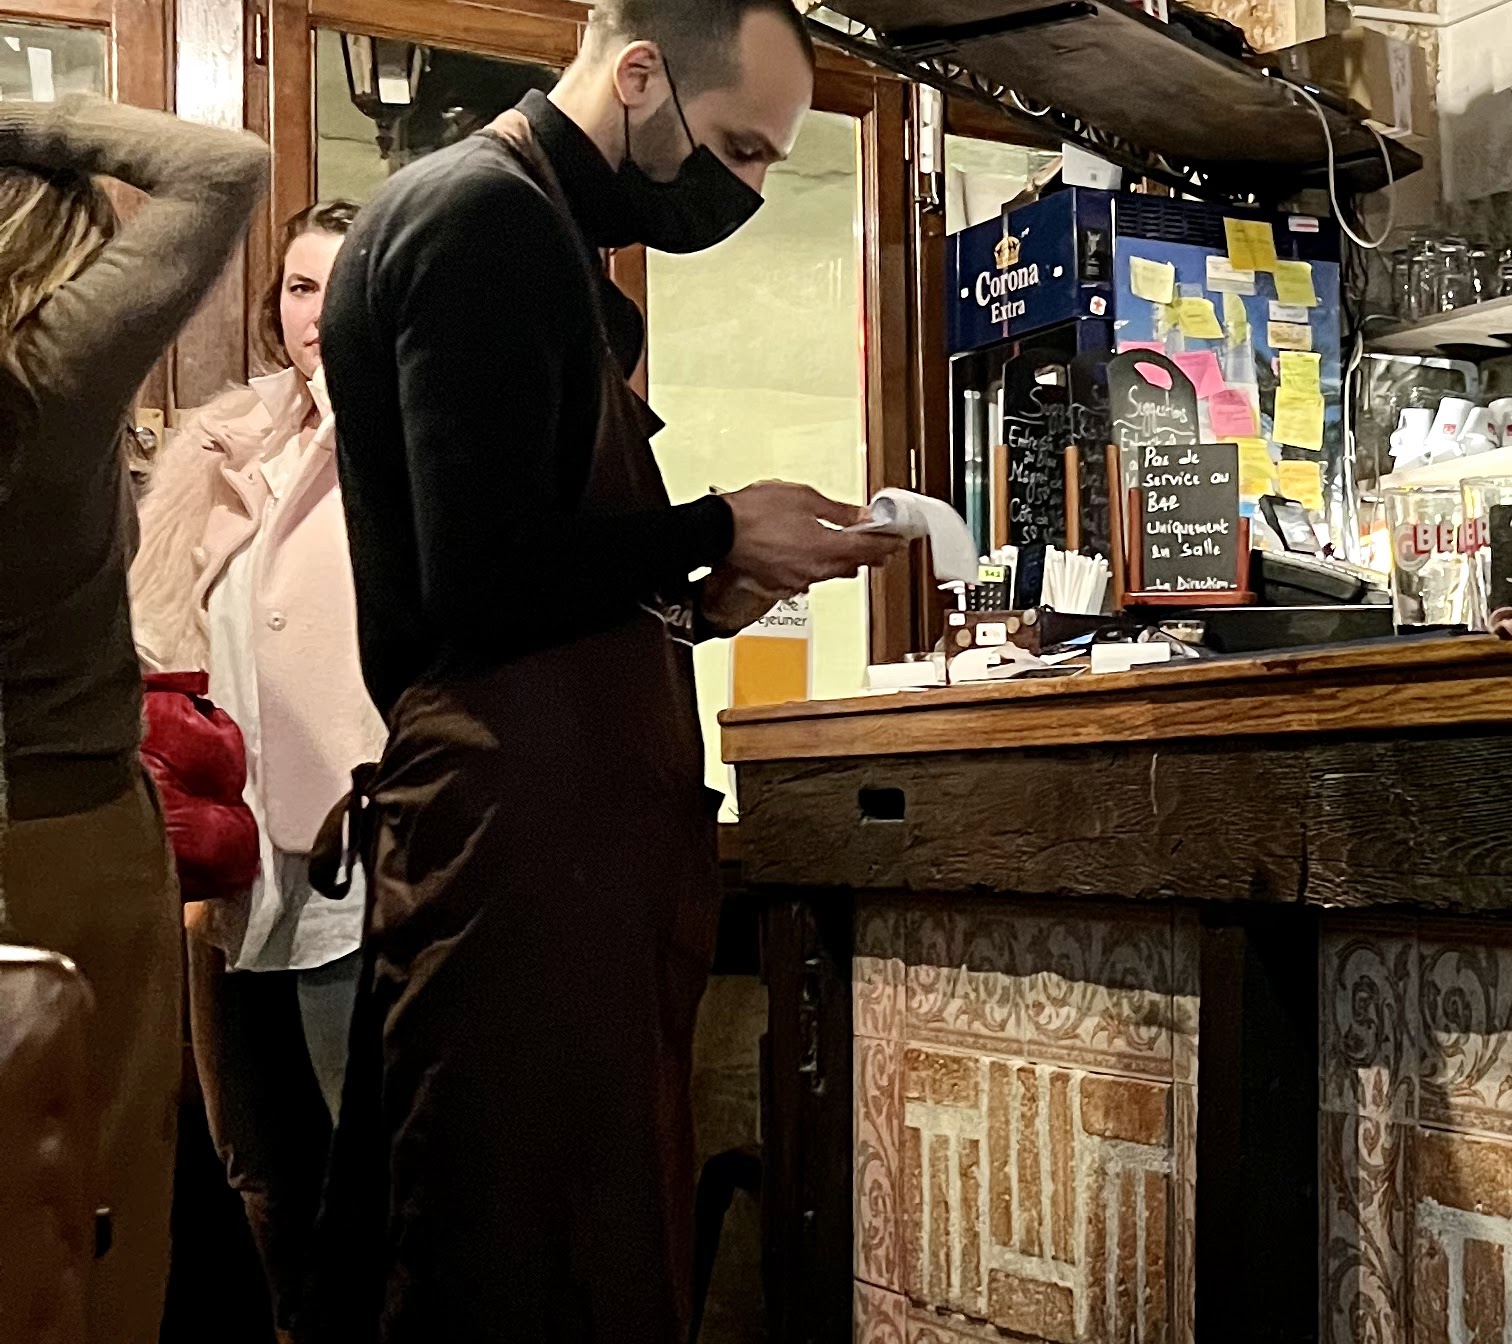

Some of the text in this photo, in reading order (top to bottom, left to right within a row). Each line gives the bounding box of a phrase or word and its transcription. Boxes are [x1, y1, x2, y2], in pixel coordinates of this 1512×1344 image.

[975, 263, 1040, 307] Corona
[990, 299, 1026, 324] Extra
[1144, 447, 1200, 468] Pas de
[1142, 472, 1230, 487] service au
